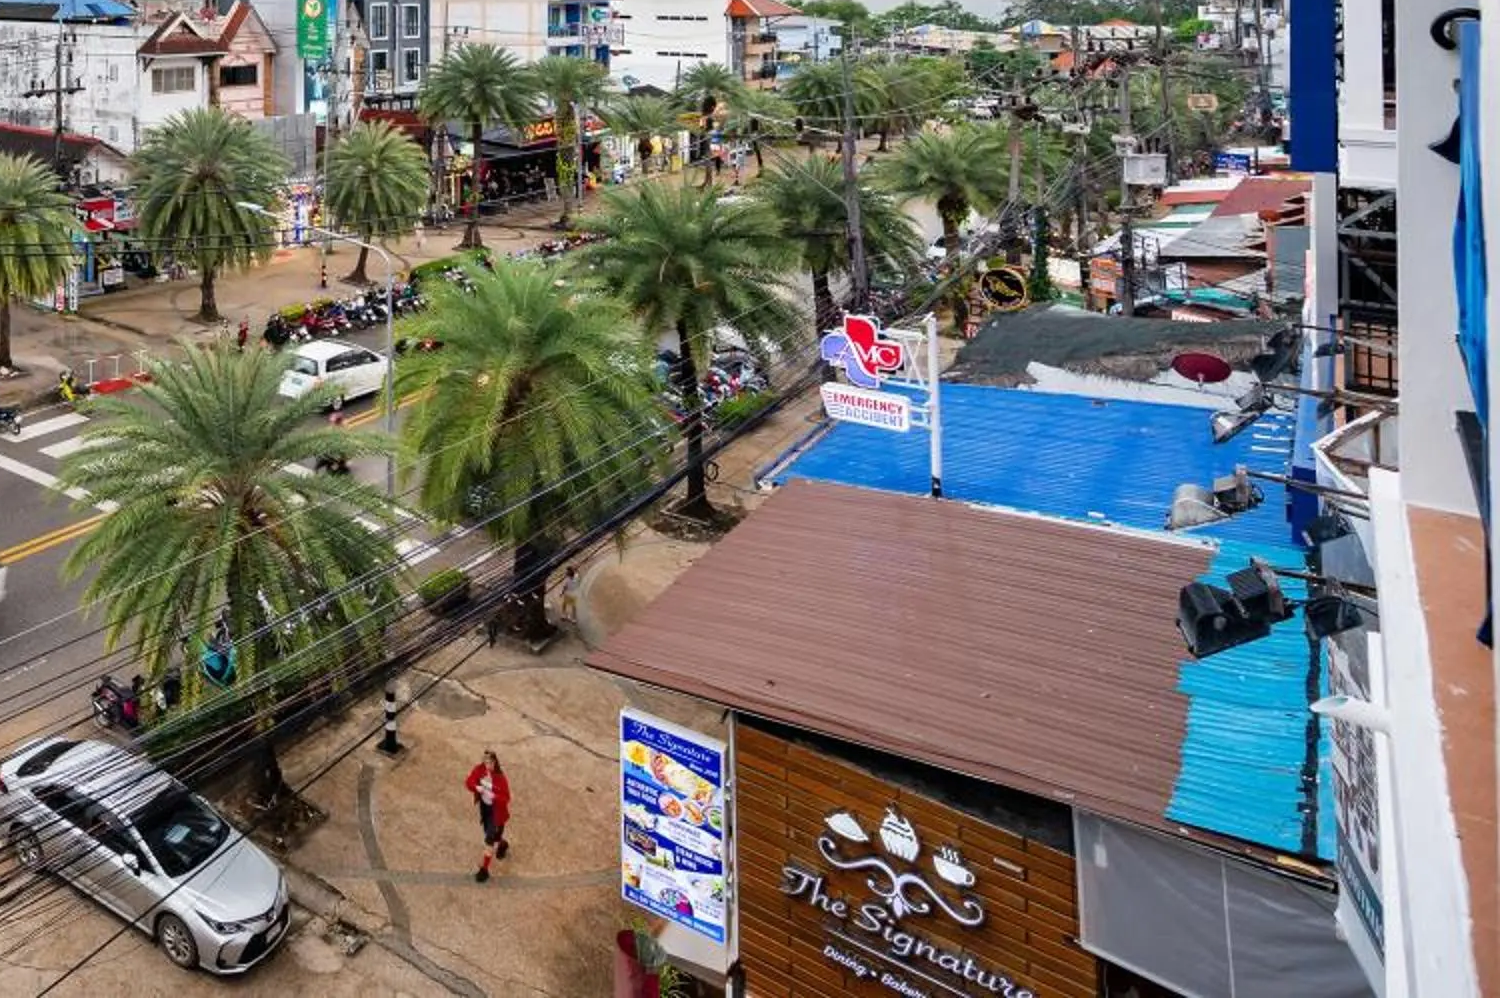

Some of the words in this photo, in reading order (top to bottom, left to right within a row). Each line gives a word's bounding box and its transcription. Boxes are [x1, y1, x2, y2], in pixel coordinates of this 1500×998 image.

[833, 393, 904, 415] EMERGENCY
[844, 407, 904, 427] ACCIDENT
[631, 721, 655, 740] The
[779, 865, 847, 918] The
[823, 945, 867, 977] Dining
[881, 973, 928, 998] Baker
